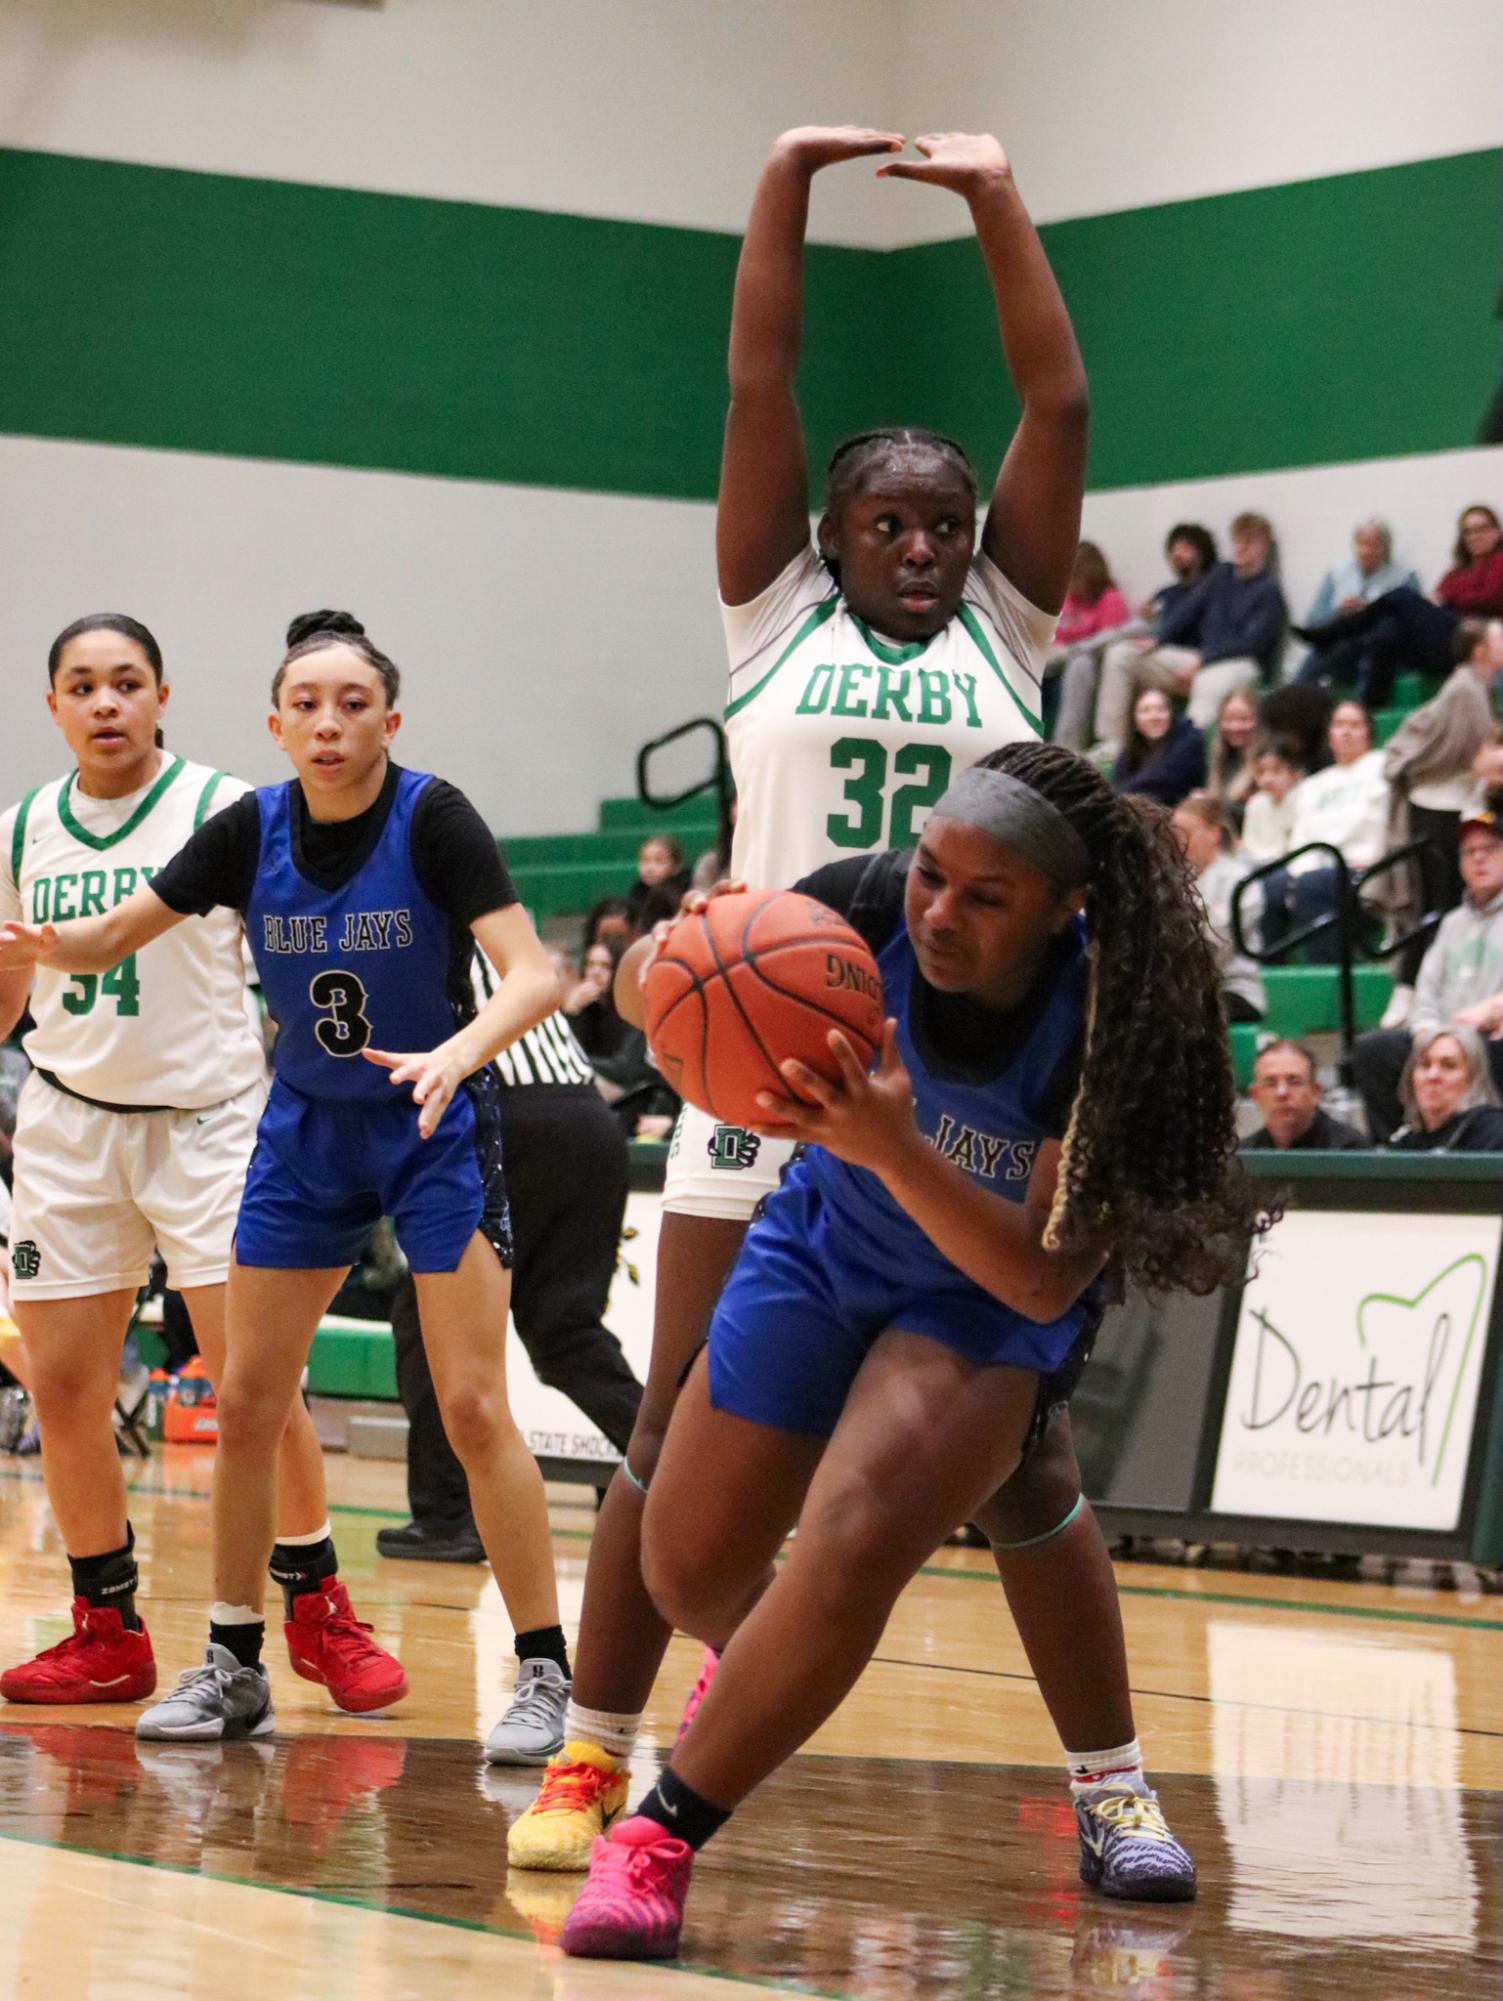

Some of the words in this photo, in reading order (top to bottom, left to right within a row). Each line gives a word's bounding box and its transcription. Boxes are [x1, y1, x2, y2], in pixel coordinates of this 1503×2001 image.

[795, 663, 983, 728] DERBY
[826, 736, 953, 851] 32
[263, 914, 328, 954] BLUE
[339, 909, 413, 951] JAYS
[309, 969, 374, 1058] 3
[923, 1113, 1035, 1180] JAYS
[1240, 1306, 1451, 1466] Dental
[530, 1430, 567, 1454] STATE
